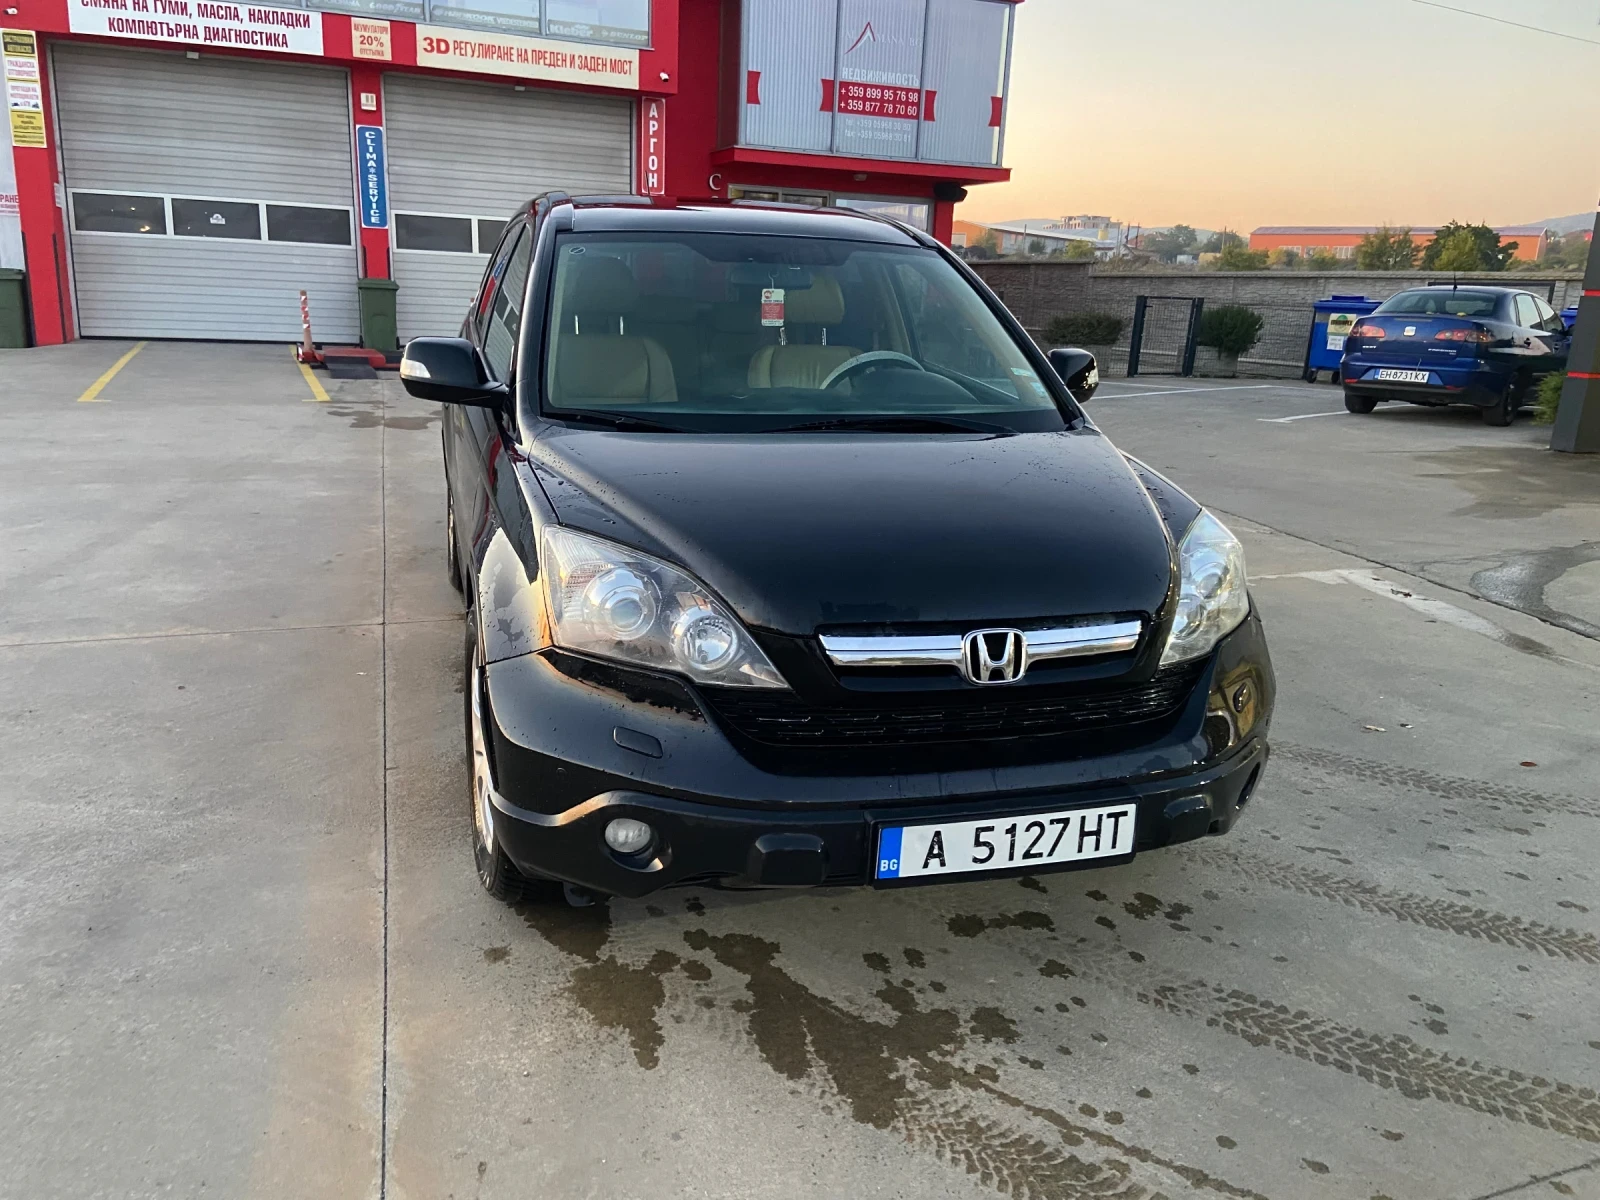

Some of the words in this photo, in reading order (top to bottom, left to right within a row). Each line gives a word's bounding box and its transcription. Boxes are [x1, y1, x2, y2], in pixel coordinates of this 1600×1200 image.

[133, 0, 149, 12] НА
[154, 0, 192, 18] ГУМИ,
[197, 3, 244, 24] МАСЛА,
[248, 8, 311, 29] НАКЛАДКИ
[108, 17, 199, 40] КОМПЮТЪРНА
[203, 25, 289, 48] ДИАГНОСТИКА
[359, 34, 384, 48] 20%
[423, 37, 450, 54] 3D
[453, 40, 514, 62] РЕГУЛИРАНЕ
[516, 48, 529, 64] НА
[531, 49, 567, 68] ПРЕДЕН
[569, 54, 576, 69] И
[577, 55, 607, 73] ЗАДЕН
[609, 58, 633, 75] МОСТ
[842, 67, 920, 87] НЕДВИЖИМОСТЬ
[847, 99, 863, 111] 359
[865, 102, 880, 113] 877
[883, 103, 893, 114] 78
[895, 104, 906, 115] 70
[907, 106, 918, 116] 60
[848, 85, 864, 98] 359
[866, 87, 882, 99] 899
[883, 90, 894, 101] 95
[896, 91, 906, 102] 76
[908, 92, 919, 103] 98
[365, 131, 377, 167] CLIMA
[648, 103, 659, 188] АРГОН
[367, 174, 381, 224] SERVICE
[880, 859, 898, 872] BG
[922, 830, 947, 869] A
